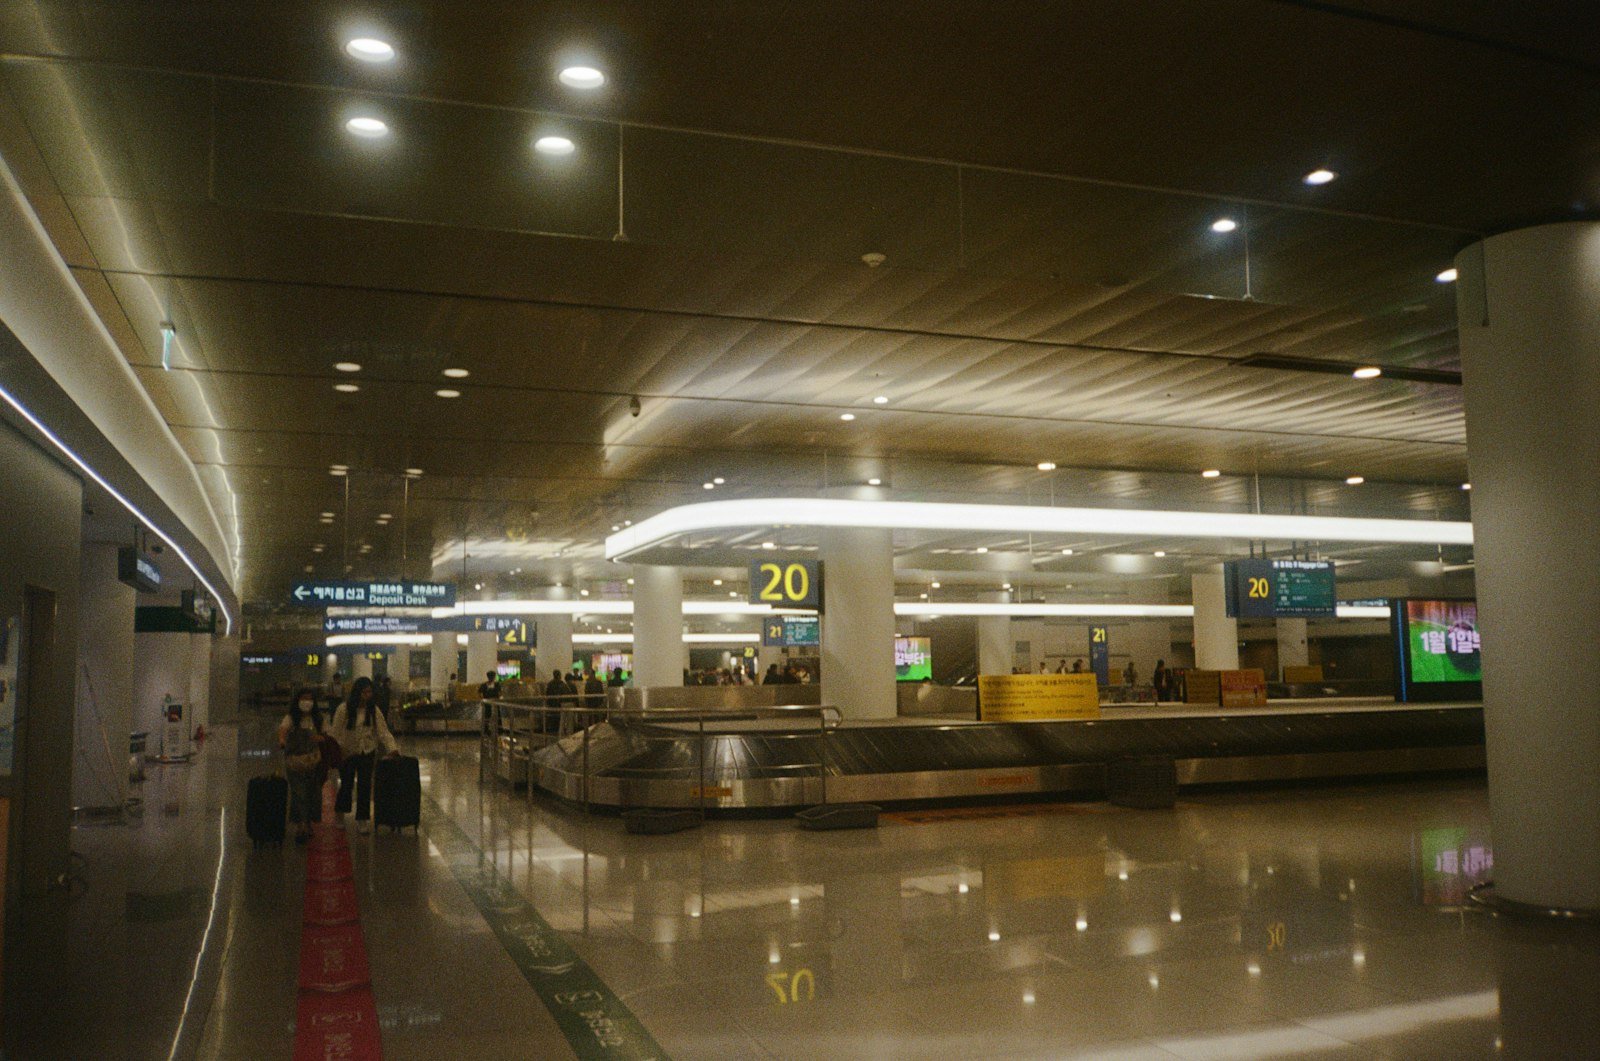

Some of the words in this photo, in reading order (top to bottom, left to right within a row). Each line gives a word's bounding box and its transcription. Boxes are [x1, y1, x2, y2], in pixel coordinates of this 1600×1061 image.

[760, 563, 809, 601] 20
[1248, 577, 1269, 598] 20
[369, 594, 403, 606] Deposit
[405, 595, 428, 605] Desk
[504, 622, 526, 643] 21
[769, 626, 782, 638] 21
[1093, 627, 1105, 643] 21
